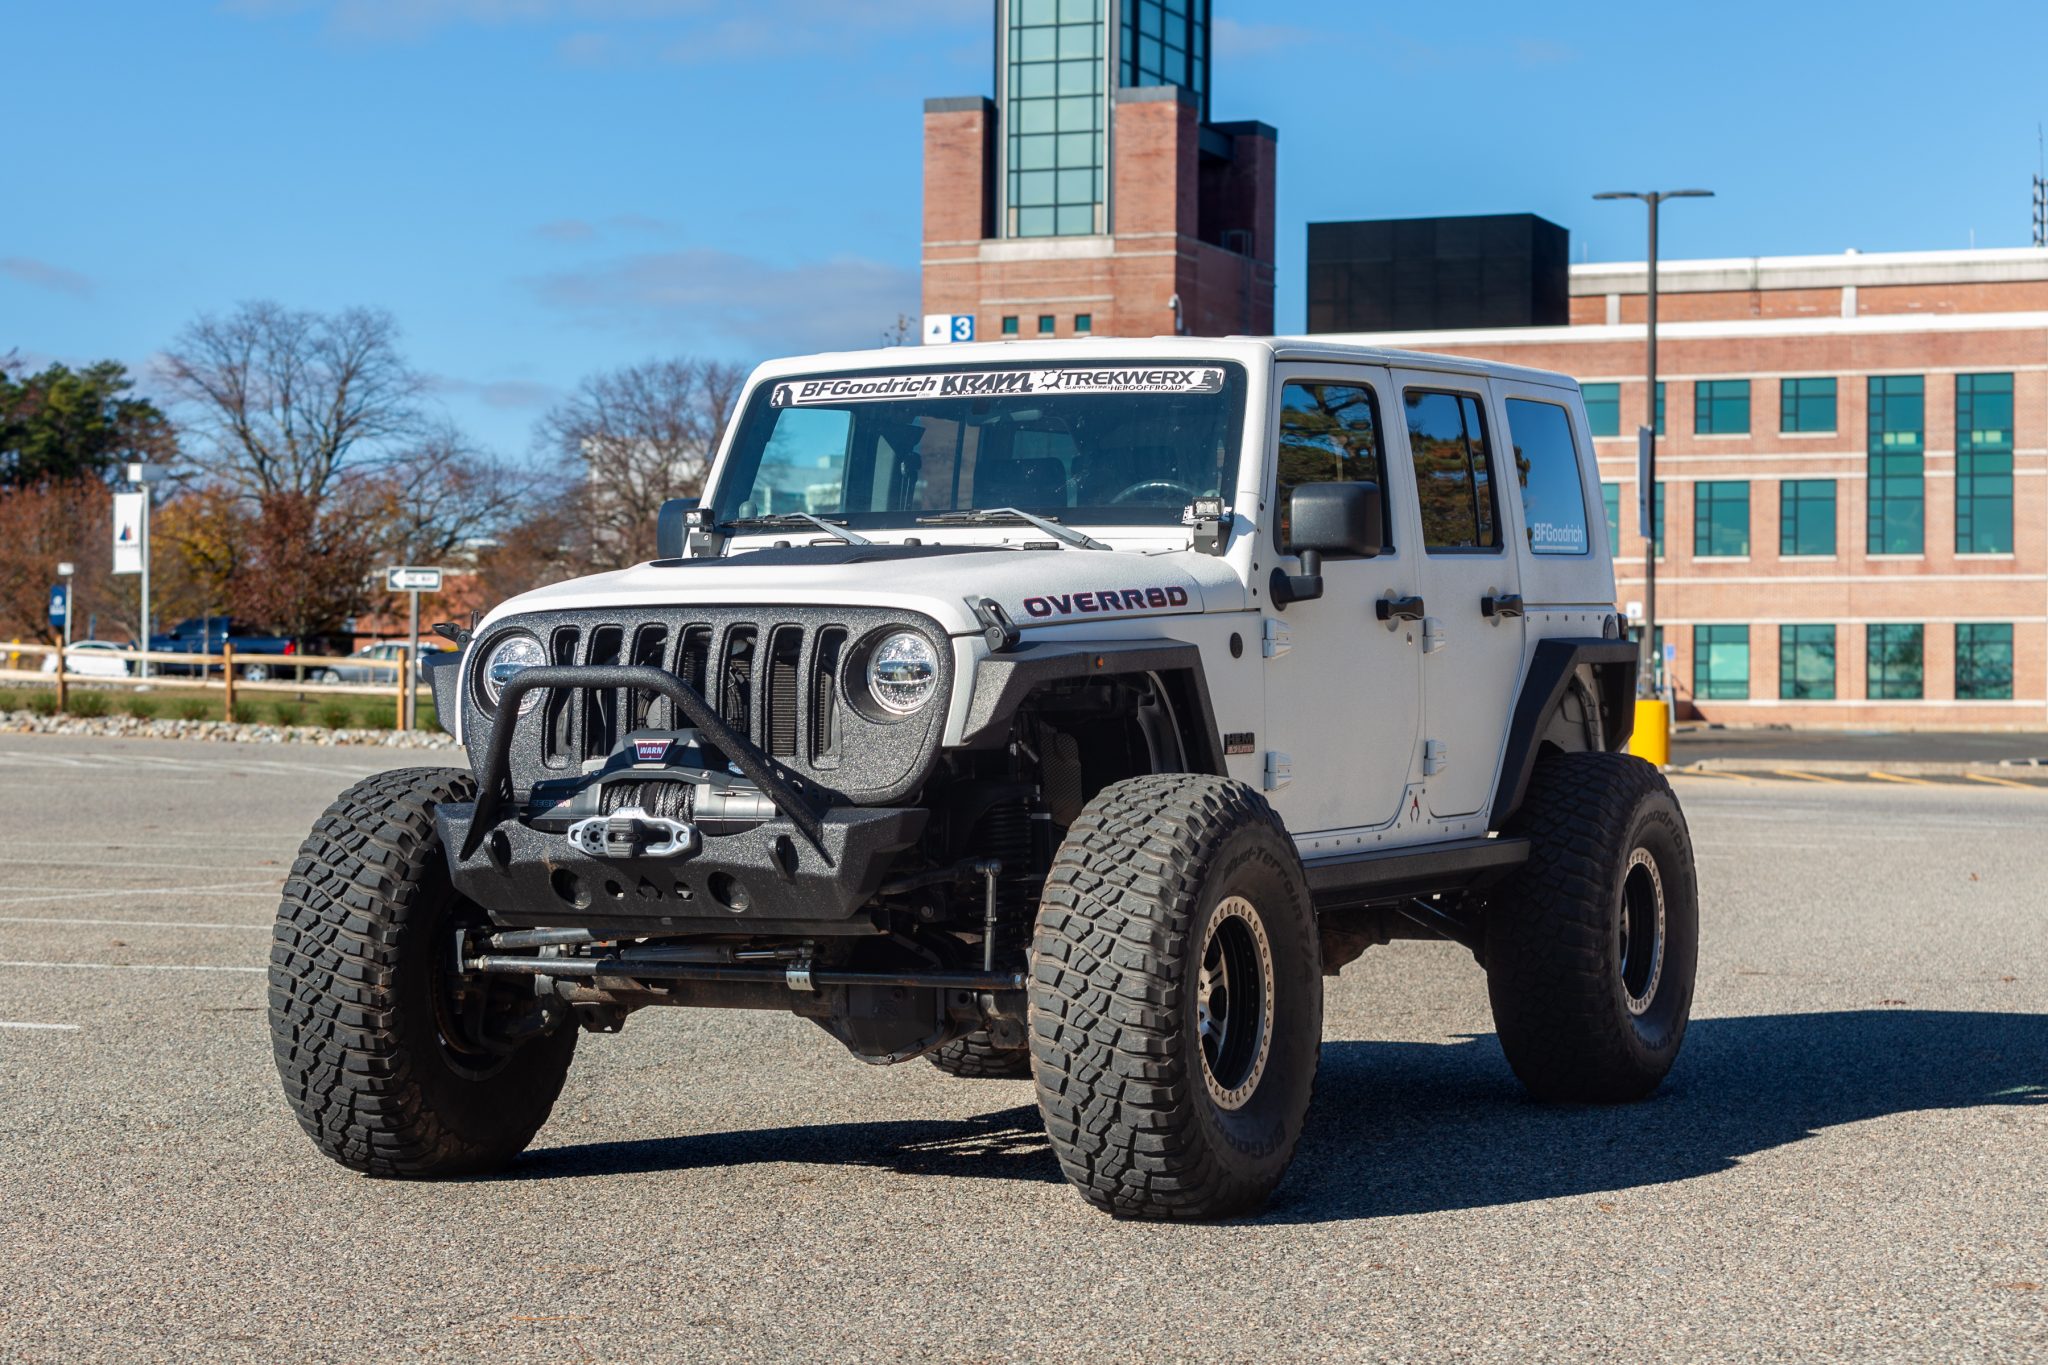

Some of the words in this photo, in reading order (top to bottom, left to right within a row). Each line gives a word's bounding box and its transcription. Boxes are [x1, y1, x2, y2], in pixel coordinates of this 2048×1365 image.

[955, 317, 971, 340] 3
[800, 376, 938, 398] BFGoodrich
[1062, 369, 1195, 386] TREKWERX
[1533, 522, 1583, 543] BFGoodrich
[639, 746, 663, 754] WARN
